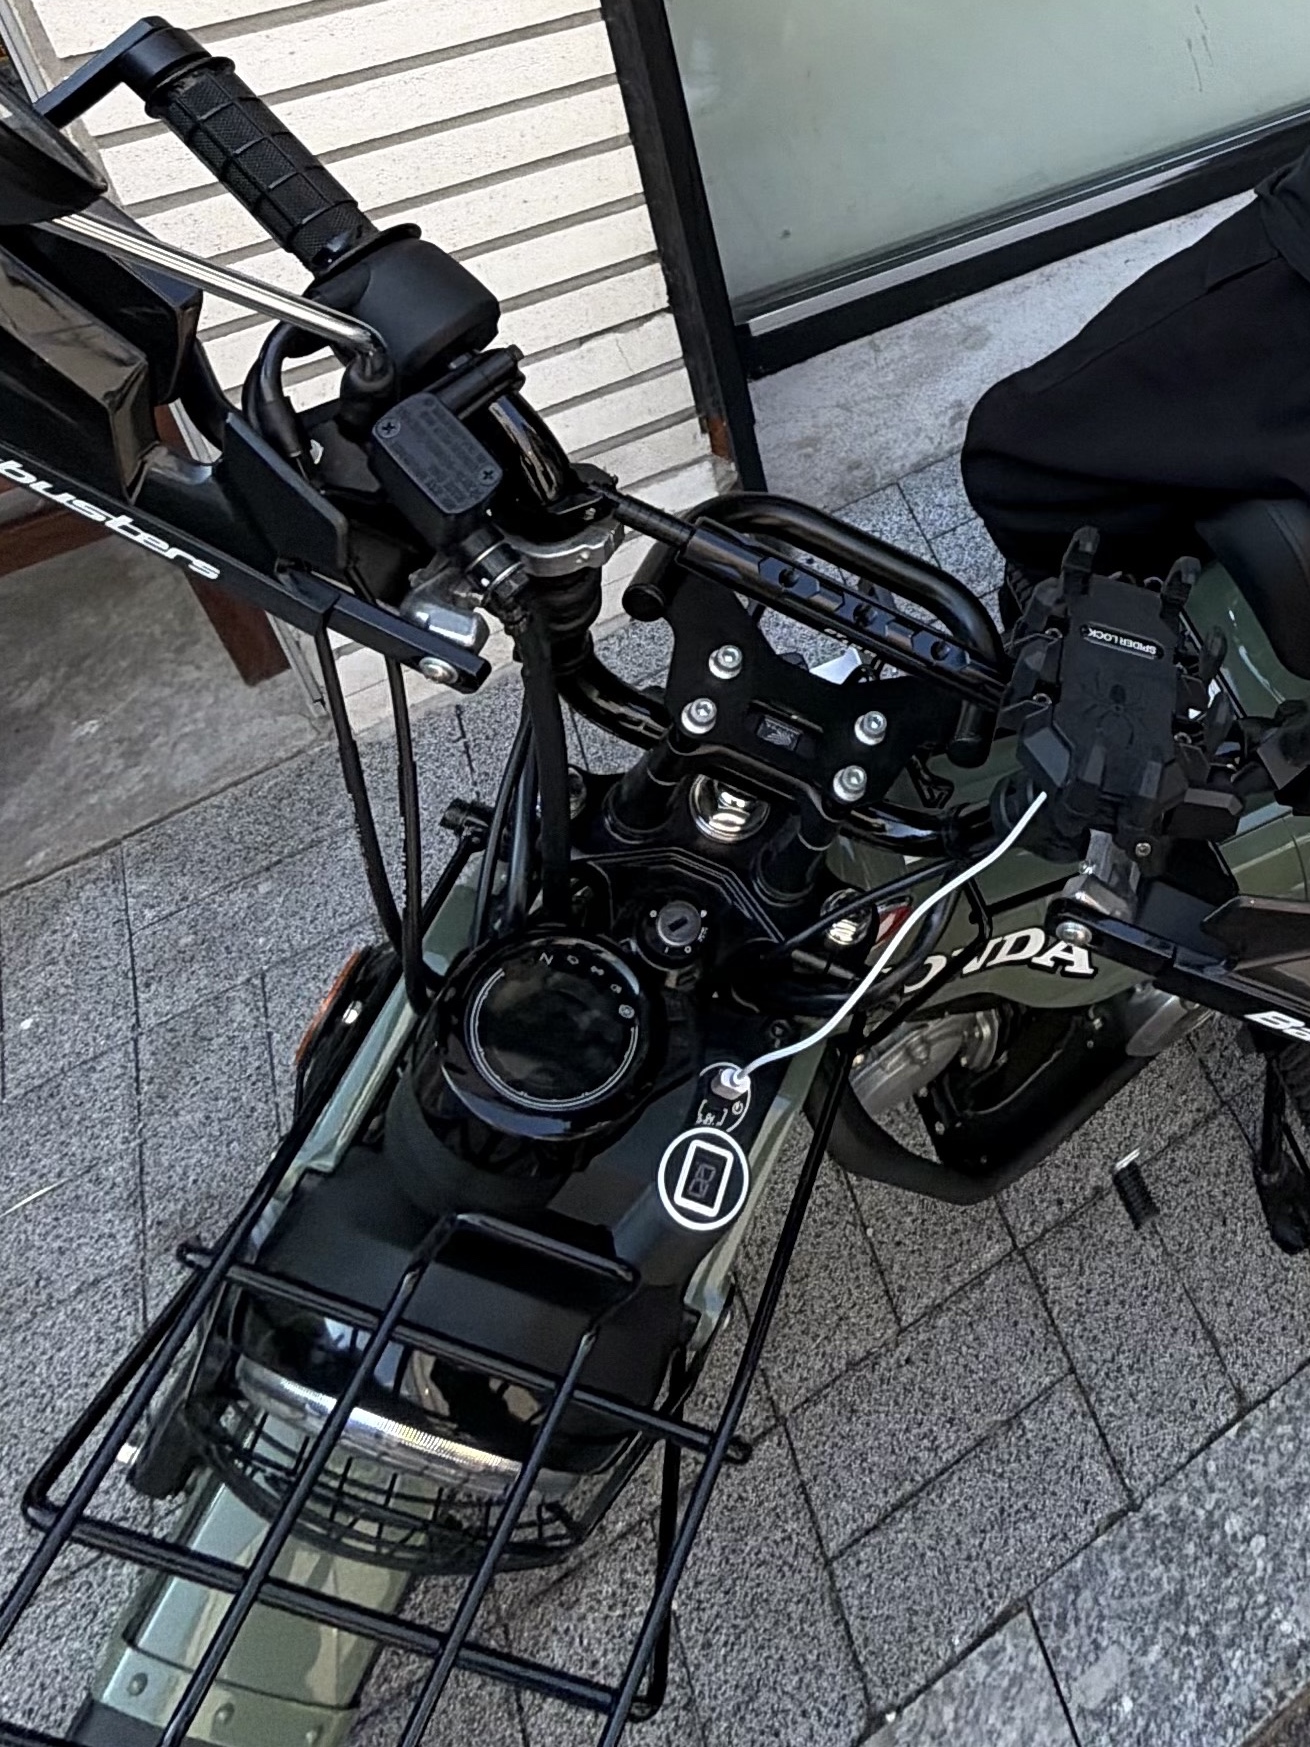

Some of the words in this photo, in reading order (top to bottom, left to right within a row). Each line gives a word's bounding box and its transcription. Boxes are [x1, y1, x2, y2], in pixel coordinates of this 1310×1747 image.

[0, 458, 221, 580] busters
[1087, 627, 1119, 644] LOCK
[1119, 635, 1157, 656] SPIDER
